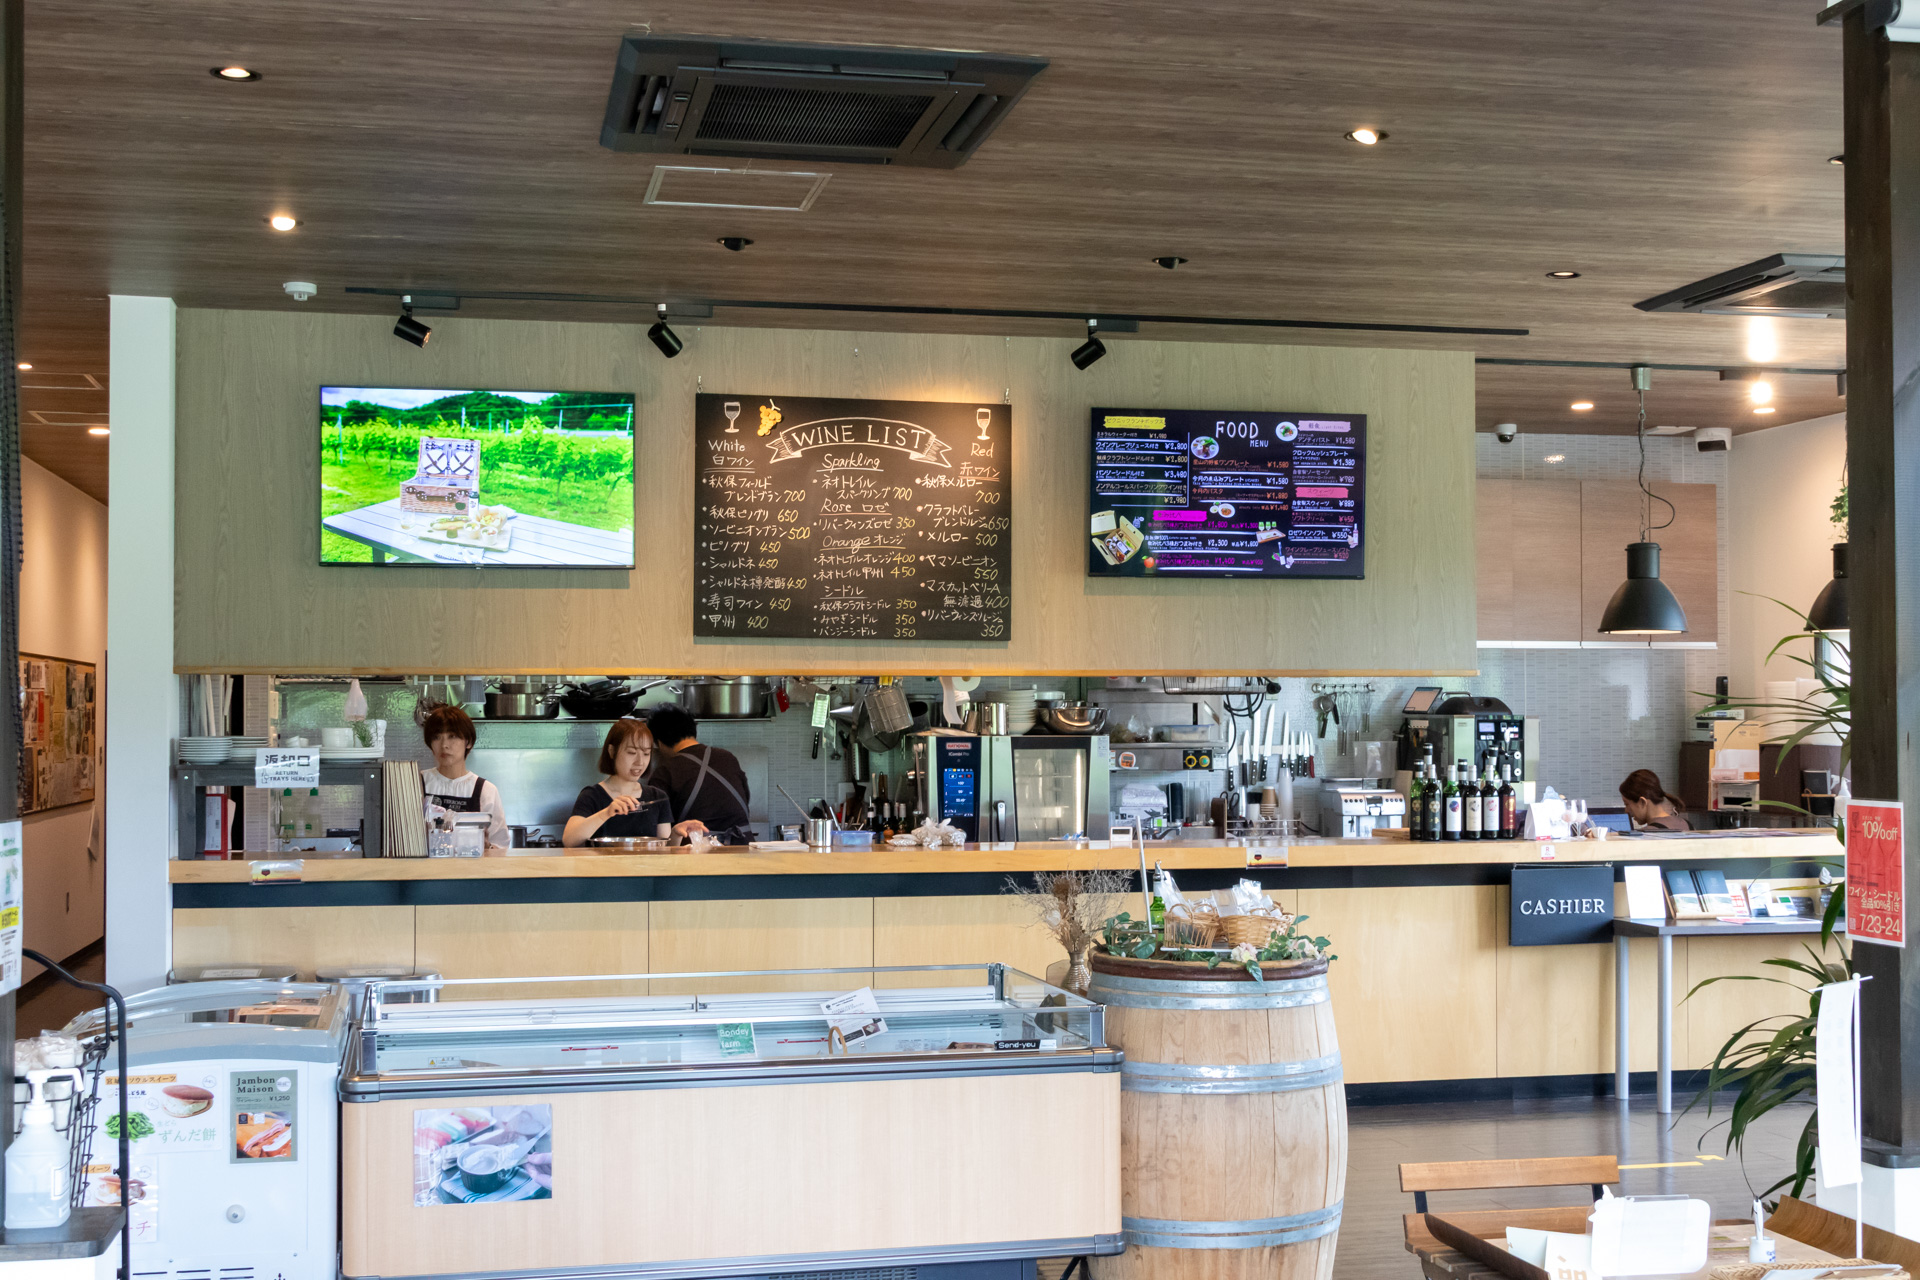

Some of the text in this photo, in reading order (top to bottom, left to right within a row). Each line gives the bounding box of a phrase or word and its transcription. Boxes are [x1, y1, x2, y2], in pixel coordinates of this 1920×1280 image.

[791, 424, 927, 449] WINE LIST
[1215, 420, 1259, 439] FOOD
[708, 439, 746, 452] White
[970, 442, 994, 458] Red
[1249, 439, 1269, 448] MENU
[713, 455, 754, 467] 白ワイン
[821, 451, 881, 473] Sparkling
[958, 462, 1001, 477] 赤ワイン
[783, 489, 806, 503] 700
[892, 486, 913, 501] 700
[975, 490, 1001, 504] 700
[820, 498, 890, 513] Rose ロゼ
[777, 509, 799, 523] 650
[895, 516, 916, 530] 350
[987, 516, 1010, 530] 650
[787, 526, 811, 540] 500
[927, 531, 998, 546] メルロー 500
[759, 541, 781, 553] 450
[822, 533, 906, 554] Orange オレンジ
[709, 556, 779, 569] シャルドネ 450
[892, 552, 916, 565] 400
[890, 566, 916, 579] 450
[973, 567, 999, 580] 550
[786, 577, 808, 590] 450
[824, 584, 865, 598] シードル
[769, 597, 791, 611] 450
[895, 599, 917, 610] 350
[984, 595, 1010, 608] 400
[708, 614, 769, 629] 甲州 400
[895, 614, 916, 625] 350
[893, 627, 917, 638] 350
[980, 623, 1004, 637] 350
[264, 754, 310, 768] 返却口
[1519, 898, 1606, 915] CASHIER
[236, 1076, 276, 1087] Jambon
[237, 1086, 274, 1094] Maison
[158, 1127, 217, 1144] ずんだ餅
